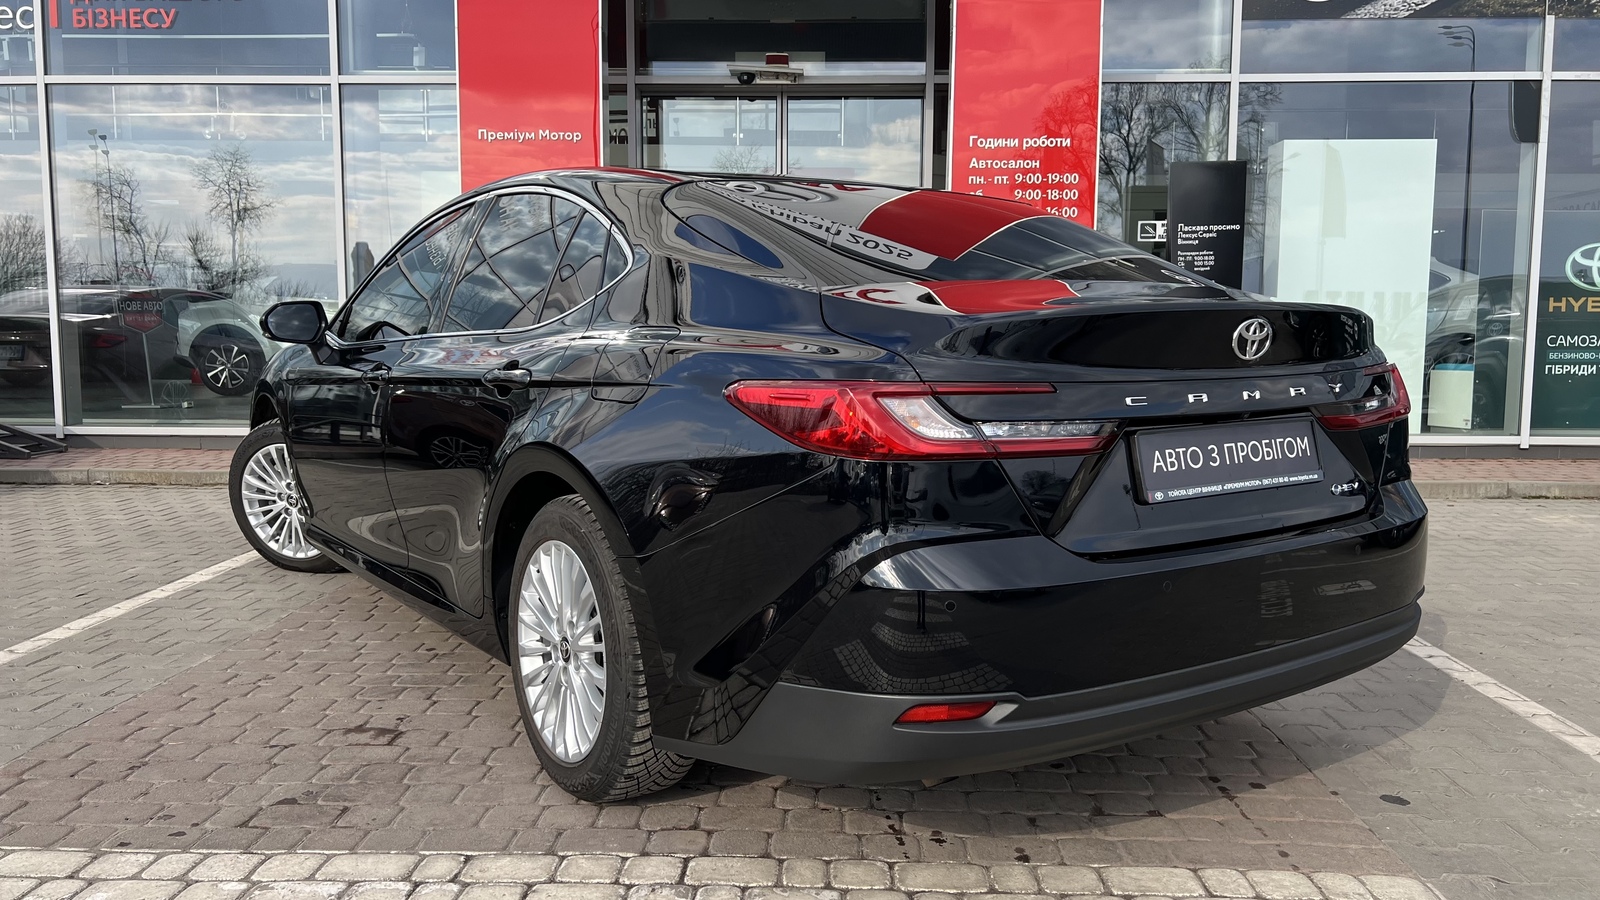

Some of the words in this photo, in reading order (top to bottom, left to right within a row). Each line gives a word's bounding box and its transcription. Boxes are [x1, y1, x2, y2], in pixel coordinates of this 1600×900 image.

[71, 8, 176, 28] БІЗНЕСУ
[477, 129, 535, 142] Преміум
[538, 129, 582, 143] Мотор
[969, 135, 1019, 149] Години
[1023, 136, 1071, 150] роботи
[969, 158, 1040, 169] Автосалон
[1014, 173, 1079, 184] 9:00-19:00
[1014, 189, 1079, 200] 9:00-18:00
[1177, 223, 1209, 232] Ласкаво
[1209, 224, 1241, 232] просимо
[119, 300, 142, 311] НОВЕ
[143, 300, 163, 311] АВТО
[1545, 364, 1597, 376] ГІБРИДИ
[1125, 382, 1342, 407] CAMRY
[1153, 446, 1203, 473] АВТО
[1207, 444, 1220, 467] З
[1223, 436, 1311, 465] ПРОБІГОМ
